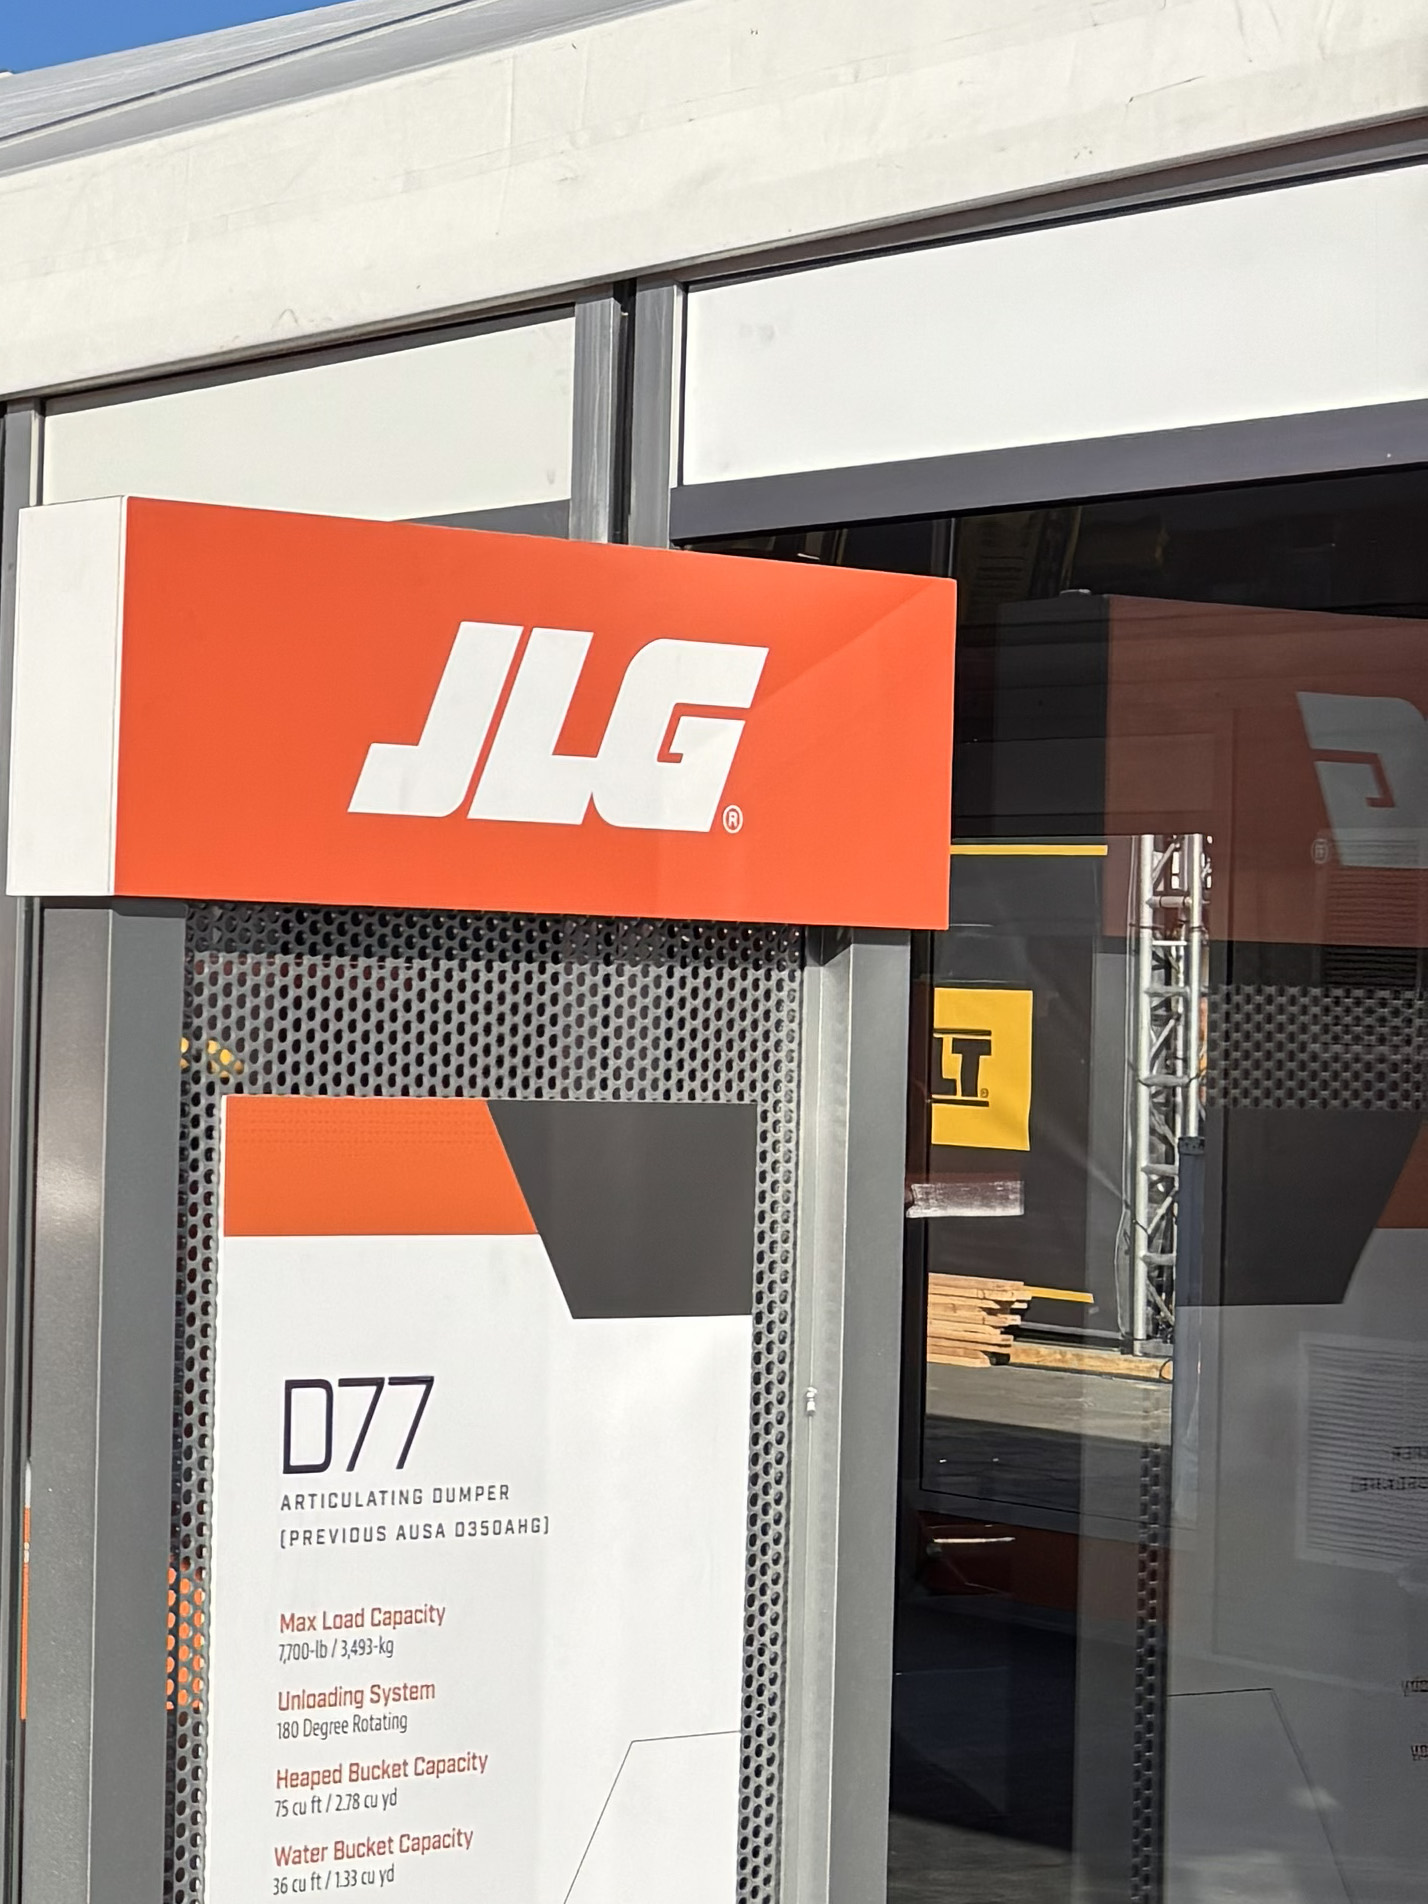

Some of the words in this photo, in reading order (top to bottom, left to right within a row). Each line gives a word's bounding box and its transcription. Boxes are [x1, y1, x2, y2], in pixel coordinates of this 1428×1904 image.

[282, 1375, 435, 1475] D77
[280, 1488, 423, 1511] ARTICULATING
[432, 1484, 510, 1505] DUMPER
[396, 1522, 446, 1541] AUSA
[279, 1612, 317, 1634] Max
[322, 1607, 365, 1631] Load
[370, 1603, 446, 1630] Capacity
[279, 1639, 328, 1664] 7,700-lb
[331, 1638, 338, 1658] /
[340, 1635, 394, 1660] 3,493-kg
[278, 1686, 364, 1712] Unloading
[369, 1682, 436, 1707] System
[277, 1720, 299, 1740] 180
[303, 1717, 349, 1741] Degree
[353, 1712, 408, 1734] Rotating
[276, 1763, 343, 1790] Heaped
[348, 1759, 409, 1783] Bucket
[414, 1751, 488, 1779] Capacity
[275, 1799, 289, 1817] 75
[292, 1801, 307, 1816] cu
[311, 1795, 323, 1814] ft
[325, 1793, 332, 1813] /
[335, 1792, 360, 1812] 2.78
[364, 1794, 378, 1809] cu
[382, 1787, 398, 1811] yd
[274, 1845, 329, 1867] Water
[333, 1836, 394, 1861] Bucket
[399, 1827, 474, 1855] Capacity
[273, 1876, 289, 1896] 36
[292, 1878, 306, 1893] cu
[310, 1871, 322, 1891] ft
[325, 1870, 332, 1890] /
[335, 1869, 358, 1888] 1.33
[361, 1871, 375, 1885] cu
[379, 1863, 395, 1888] yd
